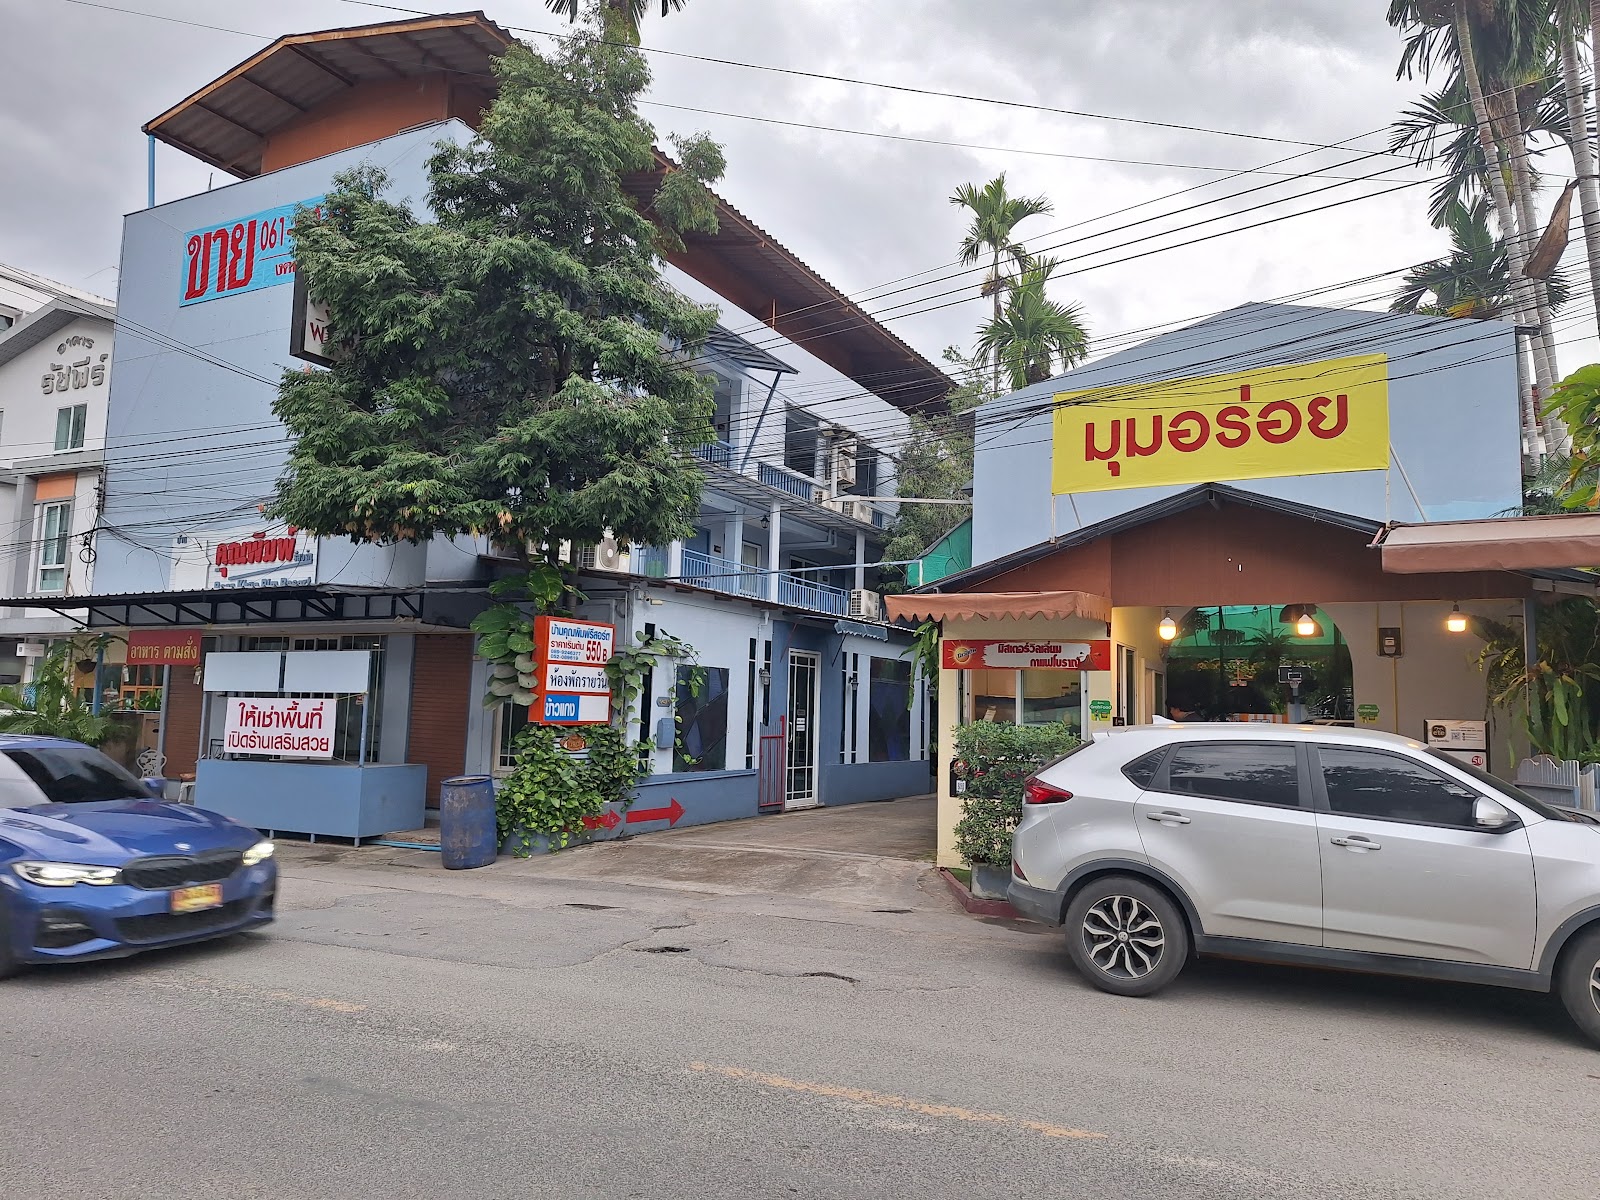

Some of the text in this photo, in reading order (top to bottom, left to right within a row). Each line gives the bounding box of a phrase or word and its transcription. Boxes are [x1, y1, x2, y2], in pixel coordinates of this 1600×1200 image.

[184, 219, 257, 301] ขาย
[1085, 384, 1349, 477] มุมอร่อย
[130, 635, 198, 660] อาหาร ตามสั่ง
[586, 640, 602, 662] 550
[239, 701, 324, 729] ให้เช่าพื้นที่
[545, 697, 576, 717] ข้าวแกง
[228, 730, 330, 752] เปิดร้านเสริมสวย
[1472, 757, 1483, 765] 50
